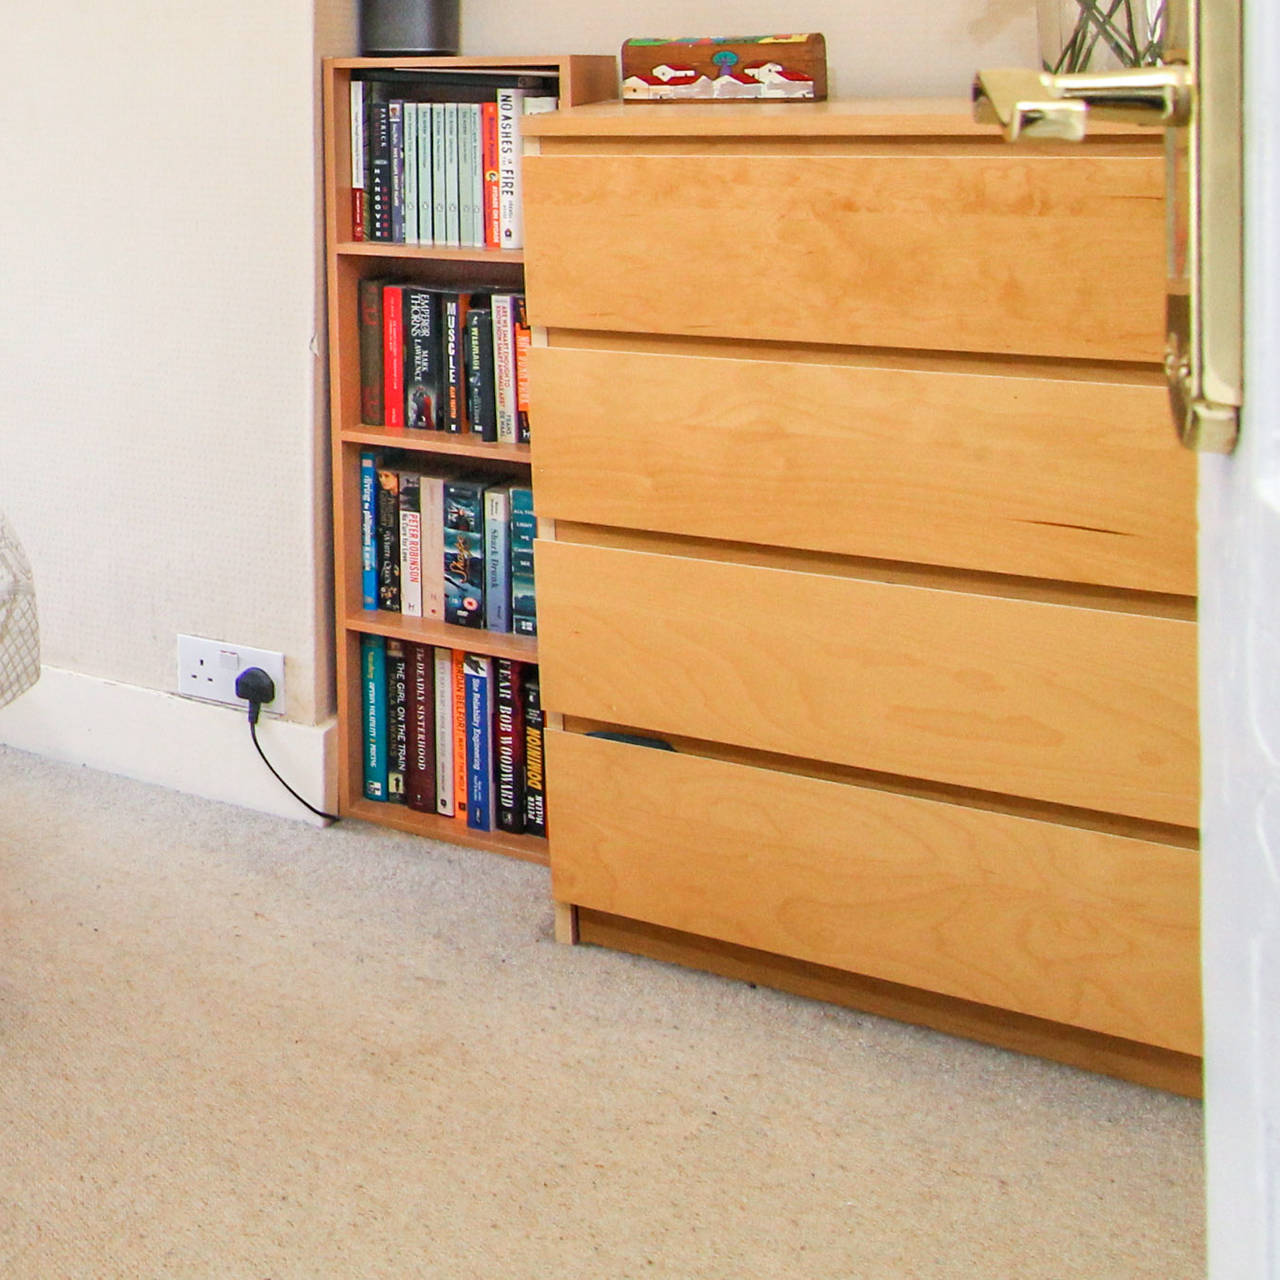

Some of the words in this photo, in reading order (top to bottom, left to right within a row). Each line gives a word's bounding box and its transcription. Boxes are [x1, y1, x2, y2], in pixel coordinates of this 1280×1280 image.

[500, 94, 513, 111] NO
[501, 115, 513, 154] ASHES
[501, 169, 515, 196] FIRE
[374, 168, 382, 238] HANGOVER
[411, 293, 422, 337] THORNS
[421, 294, 431, 337] EMPEROR
[447, 302, 457, 383] MUSCLE
[414, 338, 422, 382] LAWRENCE
[421, 350, 429, 372] MARK
[504, 379, 510, 388] TO
[408, 513, 419, 539] PETER
[490, 528, 499, 555] Shark
[409, 540, 420, 583] ROBINSON
[490, 559, 500, 589] Drunk
[416, 647, 425, 661] The
[396, 662, 406, 680] THE
[416, 662, 425, 702] DEADLY
[472, 678, 481, 691] Site
[499, 659, 513, 700] FEAR
[396, 682, 406, 704] GIRL
[397, 706, 406, 722] ON
[456, 695, 465, 733] BELFORT
[472, 692, 482, 727] Reliability
[499, 705, 513, 733] BOB
[397, 723, 407, 742] THE
[416, 704, 426, 771] SISTERHOOD
[397, 743, 407, 771] TRAIN
[472, 728, 482, 771] Engineering
[526, 726, 543, 791] DOMINION
[499, 735, 514, 808] WOODWARD
[528, 796, 536, 821] PETER
